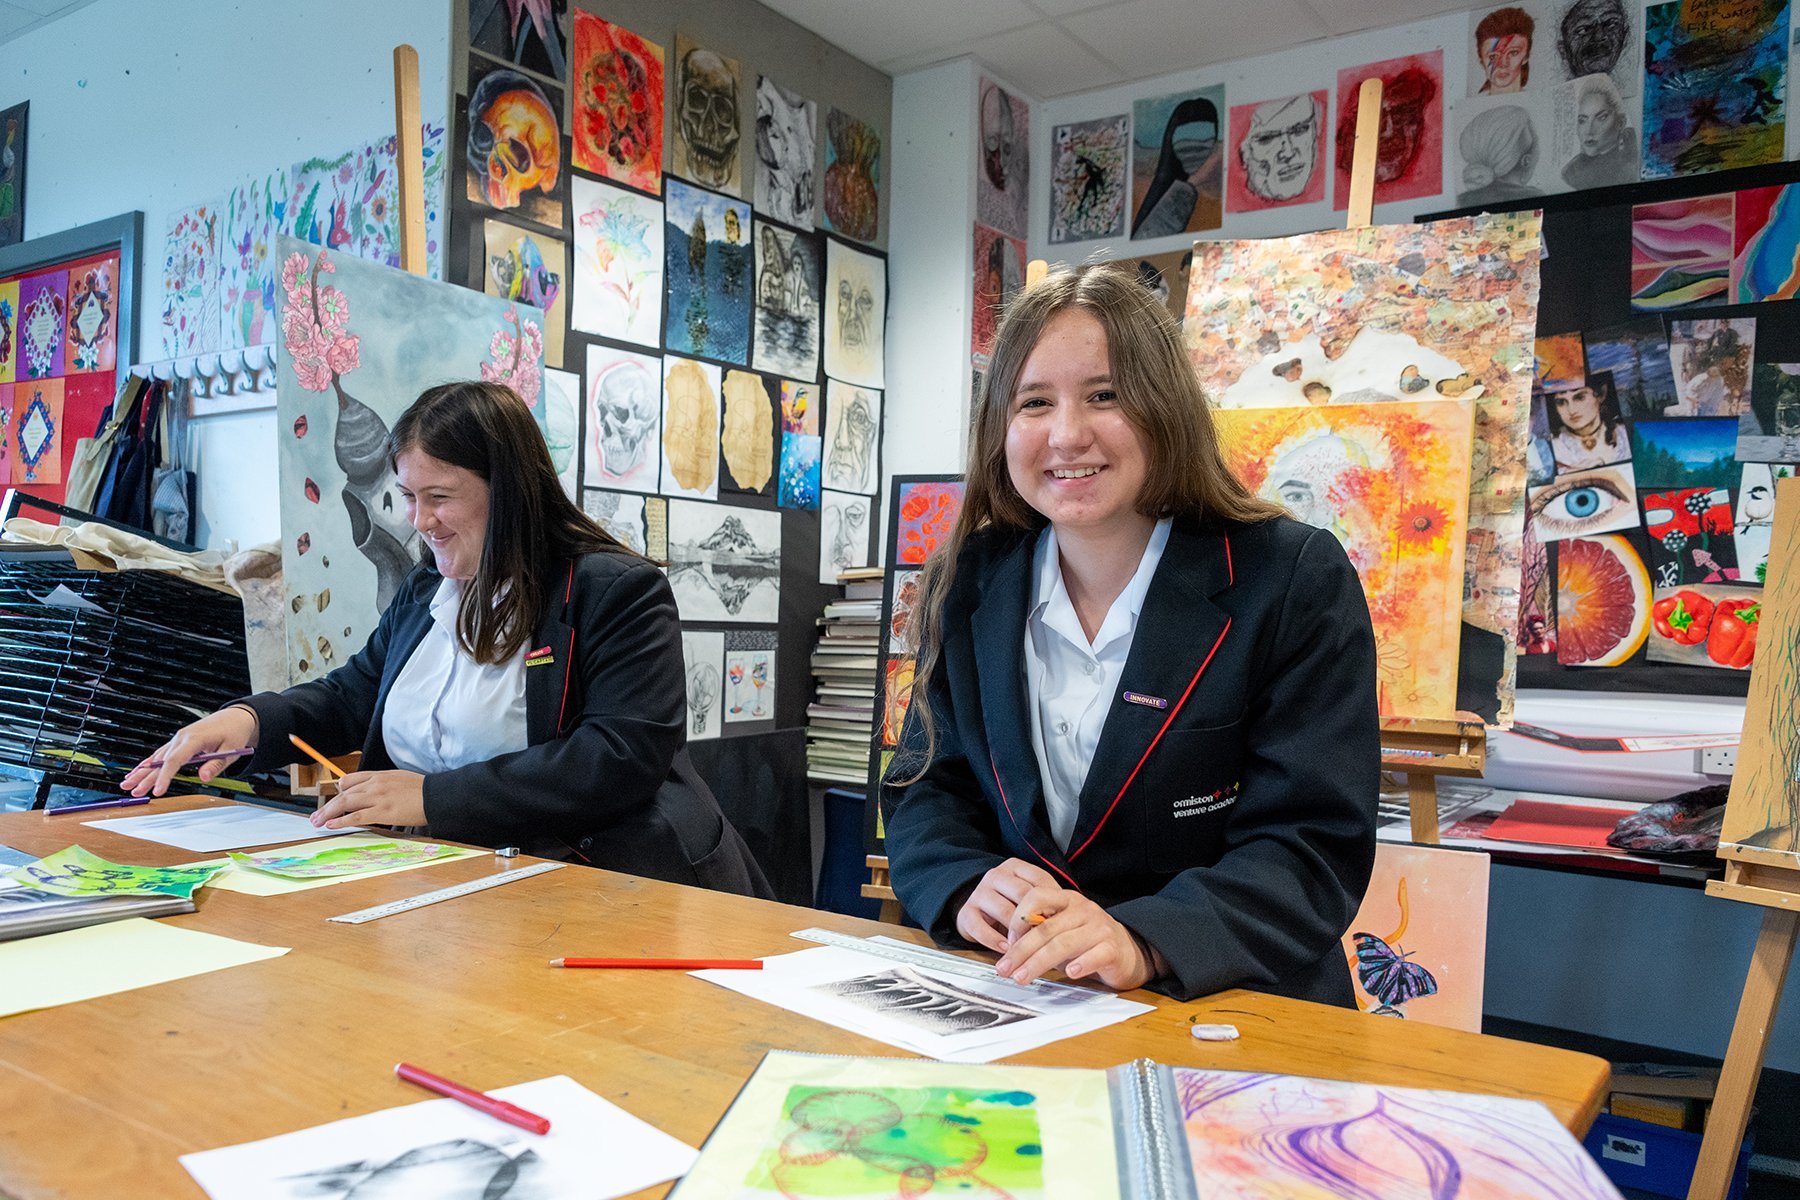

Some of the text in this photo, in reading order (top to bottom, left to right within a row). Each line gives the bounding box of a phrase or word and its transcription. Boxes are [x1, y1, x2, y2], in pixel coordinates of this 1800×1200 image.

[1687, 20, 1717, 34] FIRE
[1130, 694, 1160, 706] INNOVATE
[1173, 795, 1214, 808] ormiston
[1173, 806, 1207, 819] venture
